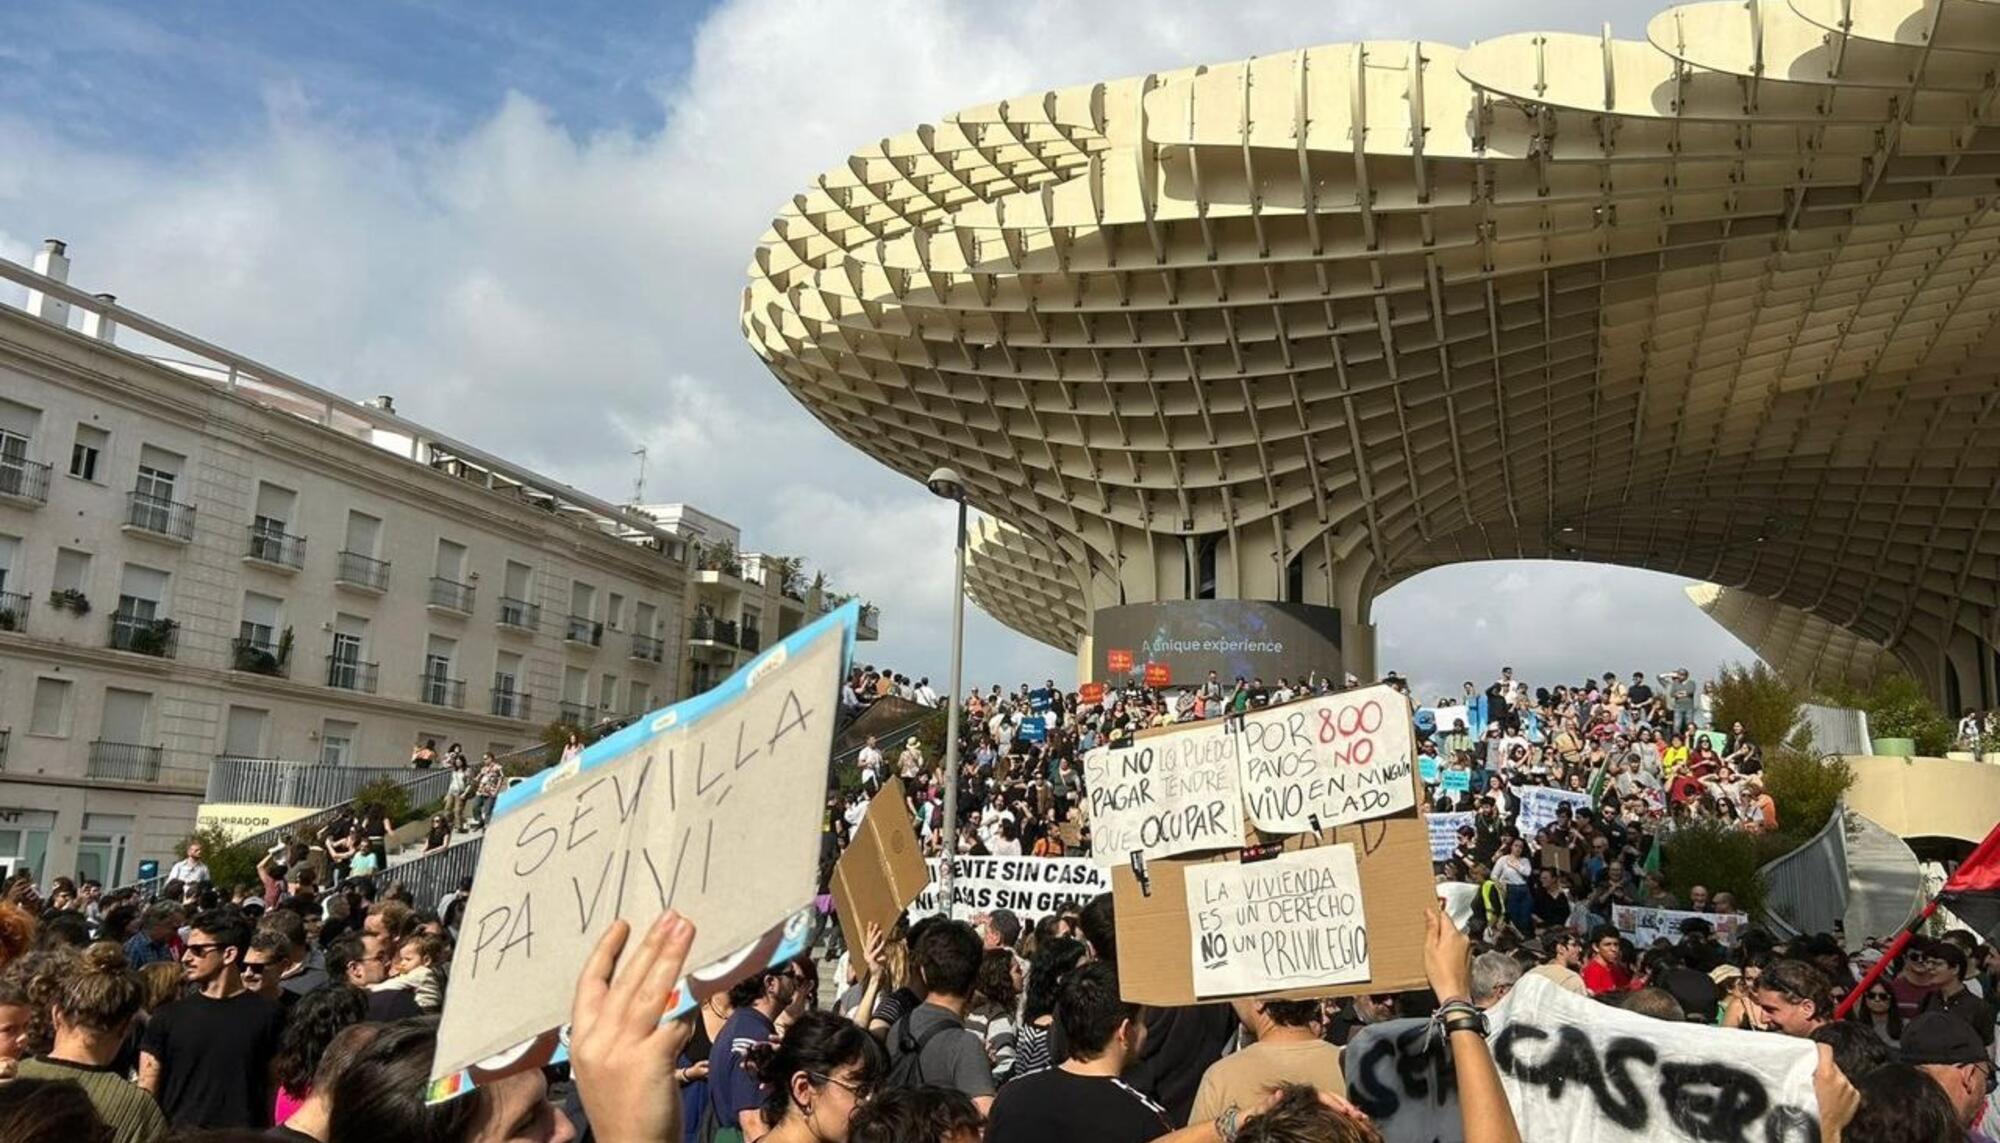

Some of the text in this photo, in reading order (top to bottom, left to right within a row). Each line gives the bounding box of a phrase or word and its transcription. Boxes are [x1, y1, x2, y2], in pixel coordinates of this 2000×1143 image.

[1142, 639, 1283, 654] A unique experience
[1244, 701, 1383, 753] POR 800
[1122, 748, 1154, 777] NO
[1248, 738, 1374, 780] PAVOS NO
[514, 690, 813, 876] SEVILLA
[1309, 774, 1345, 800] EN
[1091, 778, 1155, 818] PAGAR
[1323, 790, 1390, 819] LADO
[221, 816, 270, 827] MIRADOR
[1094, 825, 1131, 855] QUE
[953, 859, 998, 879] ENTE
[1001, 861, 1040, 883] SIN
[1043, 864, 1107, 888] CASA,
[915, 892, 934, 911] NI
[995, 889, 1032, 911] SIN
[1036, 892, 1094, 912] GENT
[1204, 879, 1229, 904] LA
[1199, 893, 1355, 931] ES UN DERECHO
[473, 893, 533, 979] PA
[1200, 932, 1228, 963] NO
[1232, 934, 1256, 953] UN
